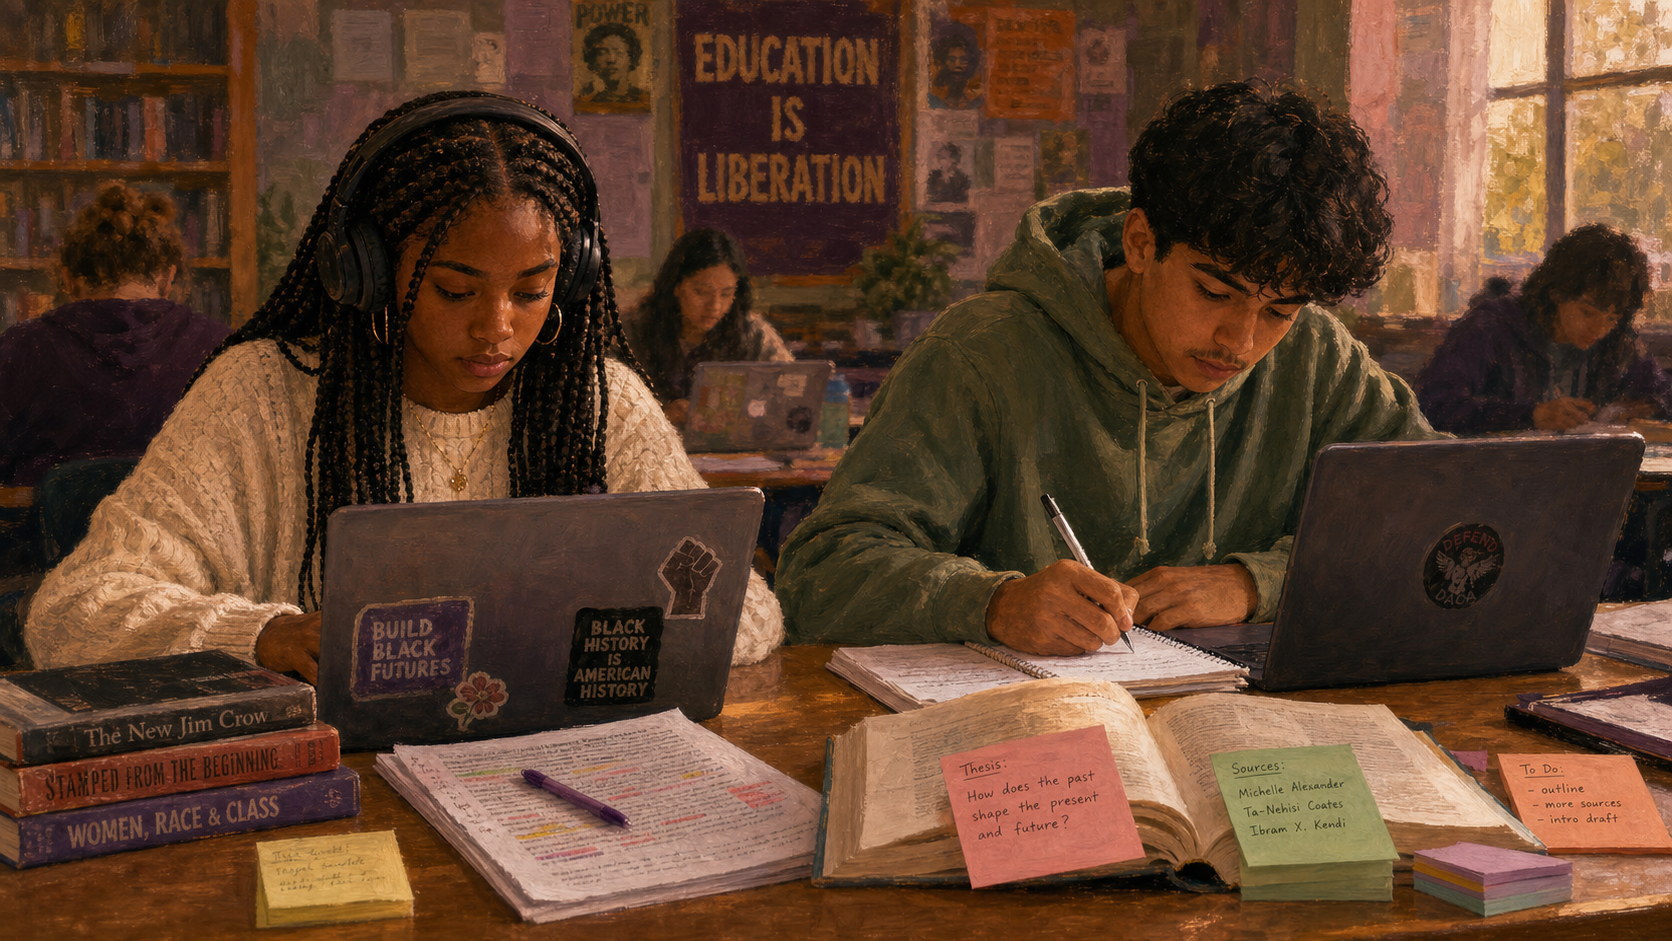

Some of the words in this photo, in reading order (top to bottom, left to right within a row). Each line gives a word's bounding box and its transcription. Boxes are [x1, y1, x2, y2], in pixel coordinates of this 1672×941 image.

[576, 1, 650, 29] POWER
[694, 33, 879, 86] EDUCATION
[771, 96, 805, 142] IS
[697, 153, 886, 203] LIBERATION
[1443, 530, 1498, 552] DEFEND
[372, 618, 433, 640] BUILD
[591, 619, 645, 635] BLACK
[372, 639, 437, 661] BLACK
[584, 636, 650, 652] HISTORY
[370, 657, 451, 681] FUTURES
[607, 653, 621, 666] IS
[573, 666, 652, 682] AMERICAN
[580, 682, 648, 699] HISTORY
[84, 726, 121, 748] The
[128, 721, 172, 743] New
[179, 716, 213, 740] Jim
[219, 709, 269, 730] Crow
[45, 768, 119, 801] STAMPED
[126, 762, 165, 790] FROM
[171, 757, 197, 783] THE
[203, 747, 278, 779] BEGINNING
[959, 759, 1007, 777] Thesis:
[1231, 761, 1285, 775] Sources:
[1519, 763, 1536, 775] To
[1543, 763, 1564, 774] Do:
[967, 789, 994, 803] How
[1002, 782, 1030, 795] does
[1038, 776, 1059, 788] the
[1067, 770, 1095, 788] past
[1238, 784, 1285, 799] Michelle
[1291, 778, 1344, 792] Alexander
[1541, 783, 1585, 794] outline
[972, 807, 1009, 822] shape
[1018, 800, 1040, 813] the
[1050, 791, 1099, 812] present
[1243, 802, 1300, 818] Ta-Nehisi
[1308, 800, 1344, 811] Coates
[1545, 800, 1574, 809] more
[1581, 799, 1622, 808] sources
[67, 815, 149, 849] WOMEN,
[155, 806, 202, 835] RACE
[209, 807, 221, 827] &
[226, 795, 280, 824] CLASS
[1250, 824, 1287, 837] Ibram
[1294, 822, 1307, 833] X.
[1314, 818, 1346, 830] Kendi
[1550, 815, 1579, 824] intro
[1586, 812, 1618, 823] draft
[978, 825, 1002, 840] and
